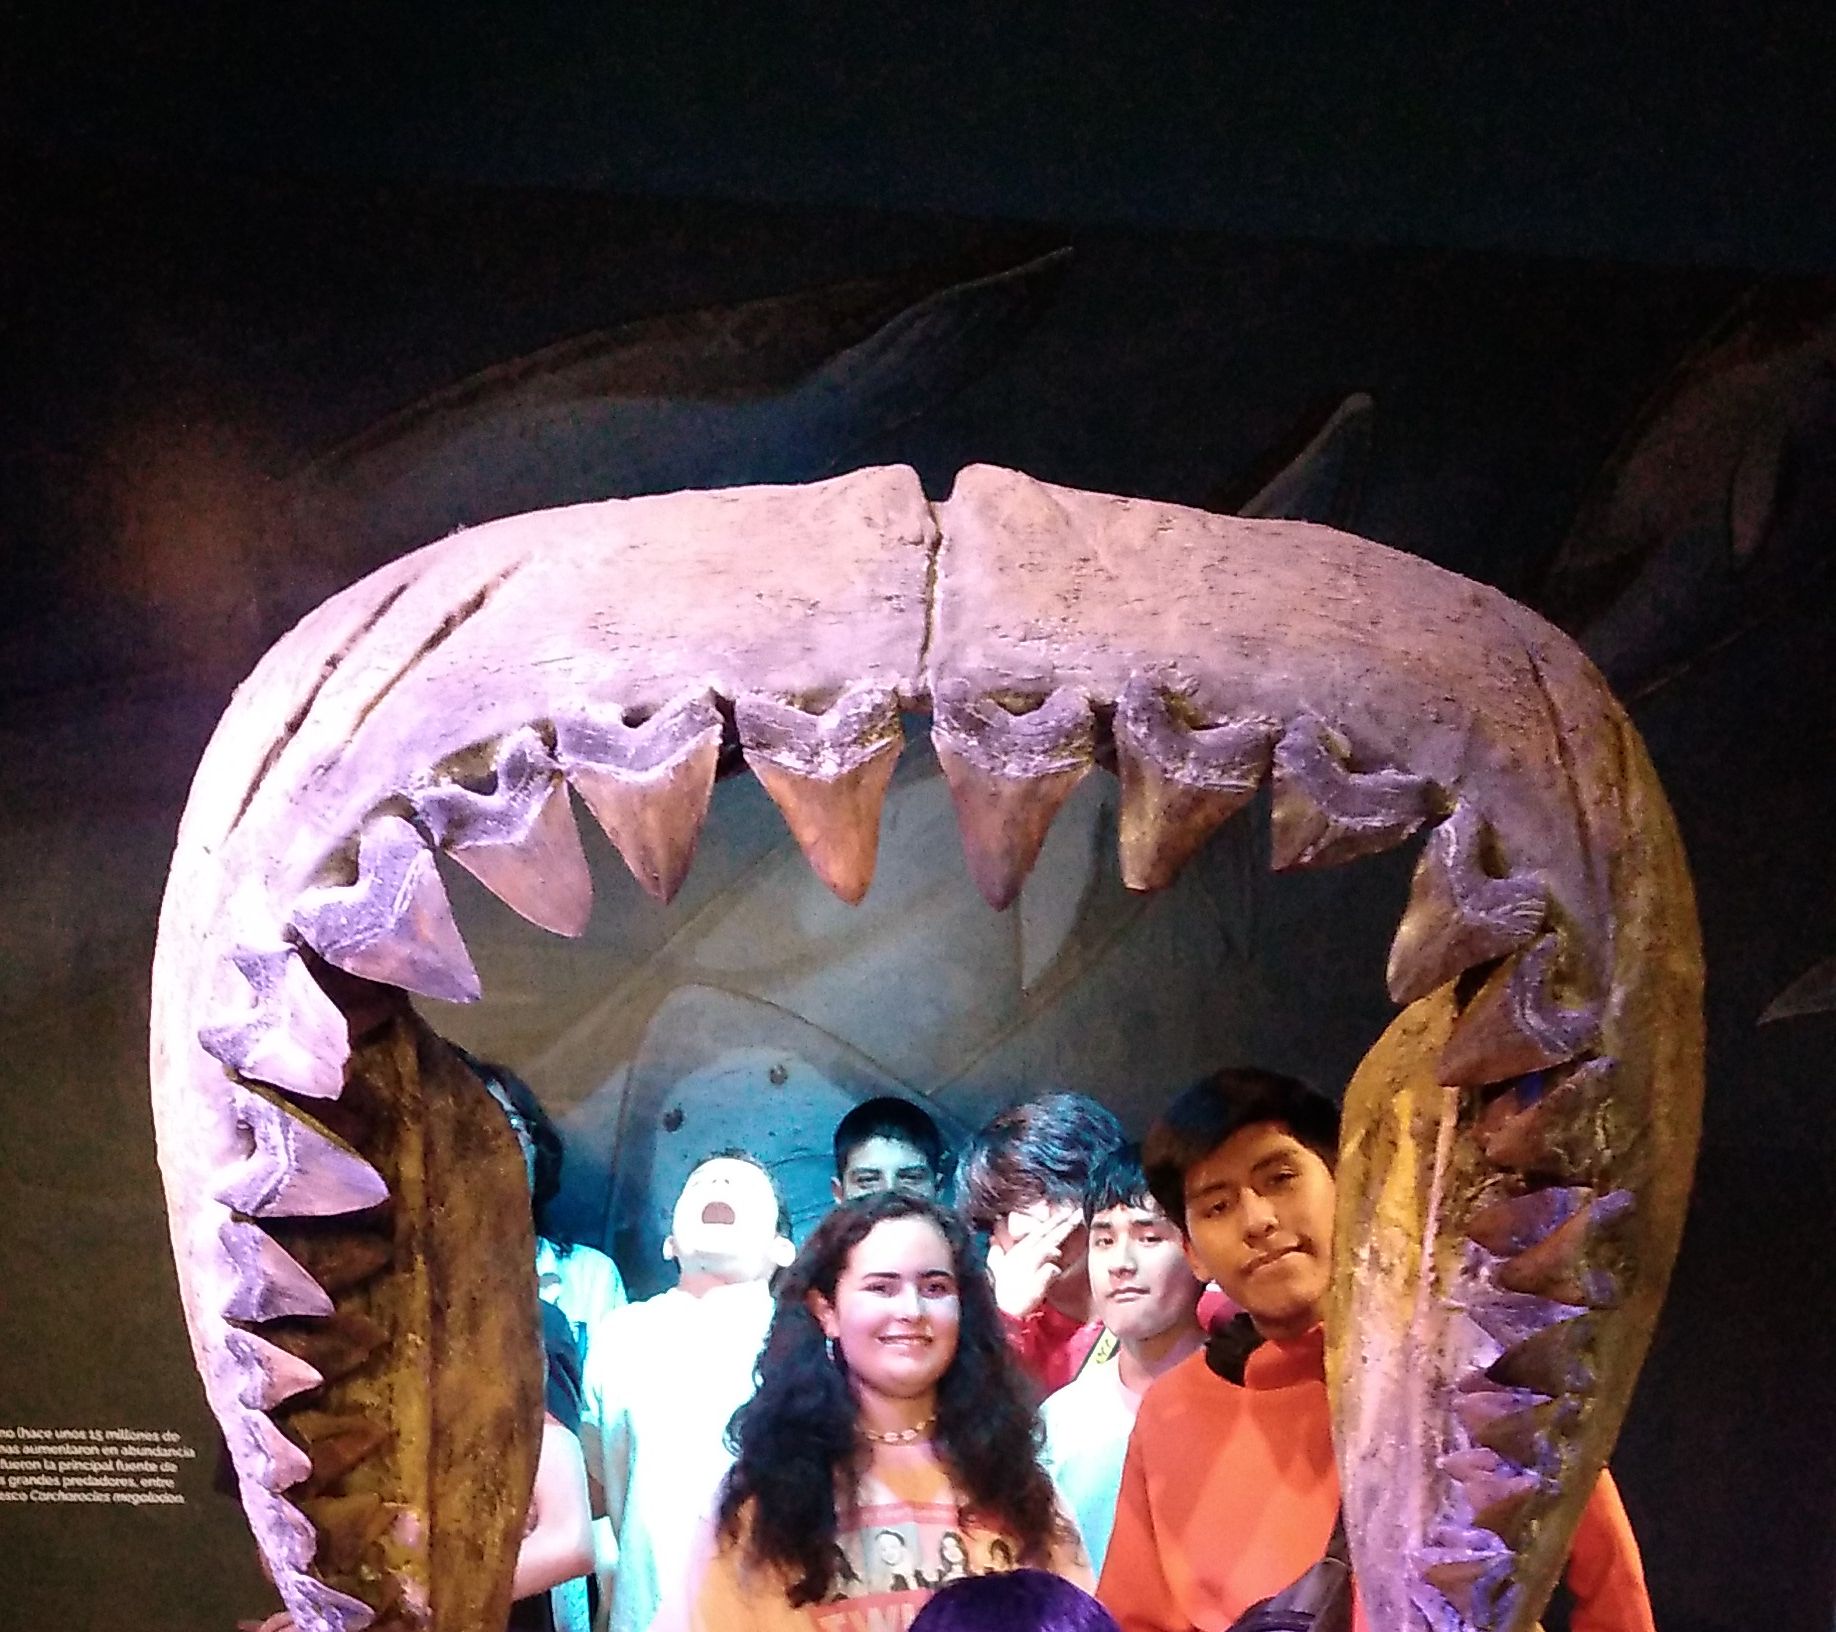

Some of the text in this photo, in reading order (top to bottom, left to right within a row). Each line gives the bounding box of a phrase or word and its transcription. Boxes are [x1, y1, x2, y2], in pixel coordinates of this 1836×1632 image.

[55, 1429, 87, 1440] unos
[105, 1428, 160, 1442] millones
[161, 1430, 180, 1442] de
[22, 1443, 100, 1455] aumentaron
[101, 1446, 119, 1456] en
[120, 1444, 196, 1458] abundancia
[43, 1458, 57, 1471] la
[58, 1459, 115, 1473] principal
[115, 1459, 158, 1472] fuente
[160, 1460, 178, 1473] de
[7, 1474, 60, 1489] grandes
[140, 1477, 175, 1489] entre
